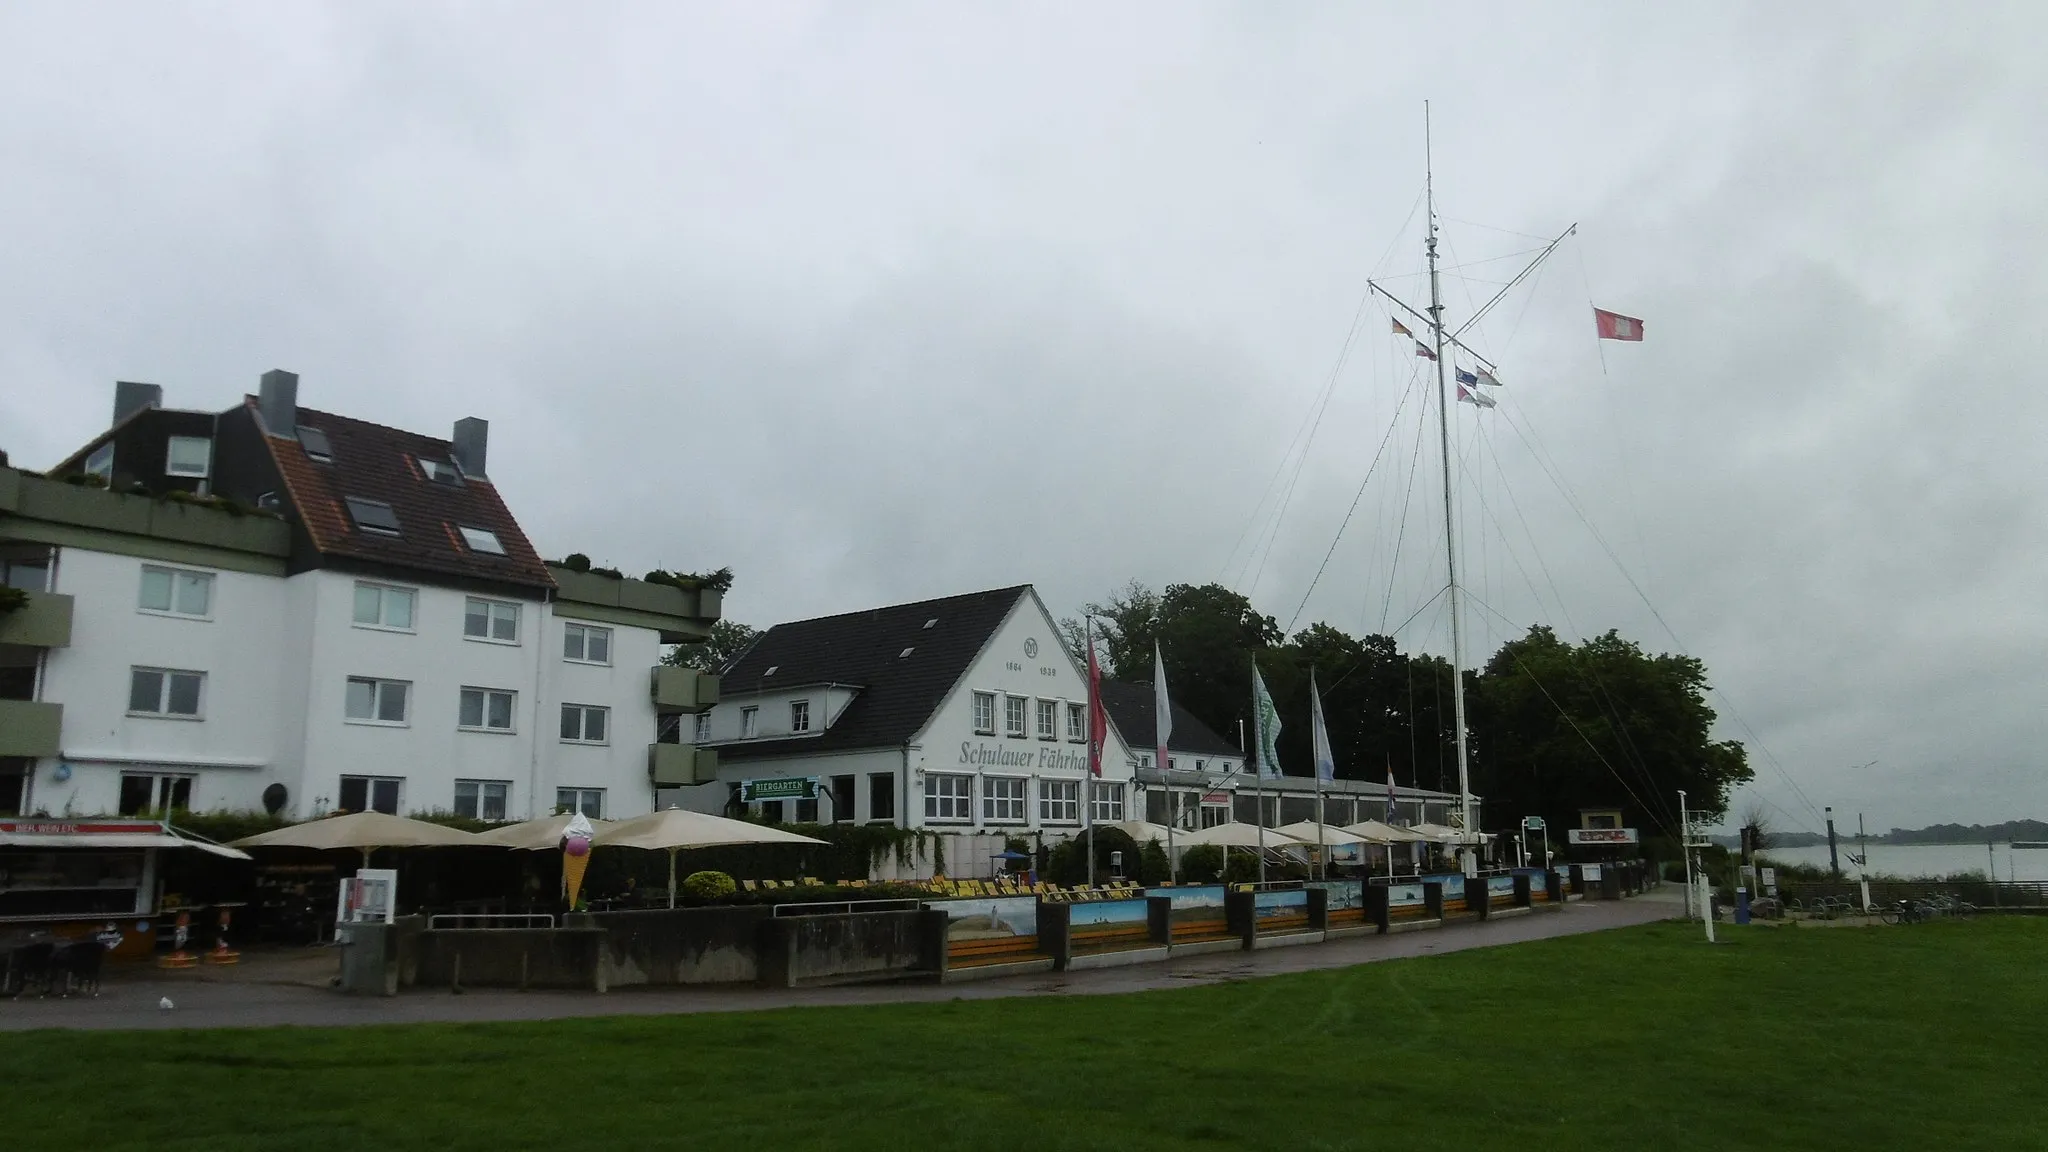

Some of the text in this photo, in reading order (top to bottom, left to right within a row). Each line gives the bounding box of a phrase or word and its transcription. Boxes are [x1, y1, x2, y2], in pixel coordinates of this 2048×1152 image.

[959, 741, 1088, 771] Schulauer Fährha
[755, 781, 803, 792] BIERGARTEN
